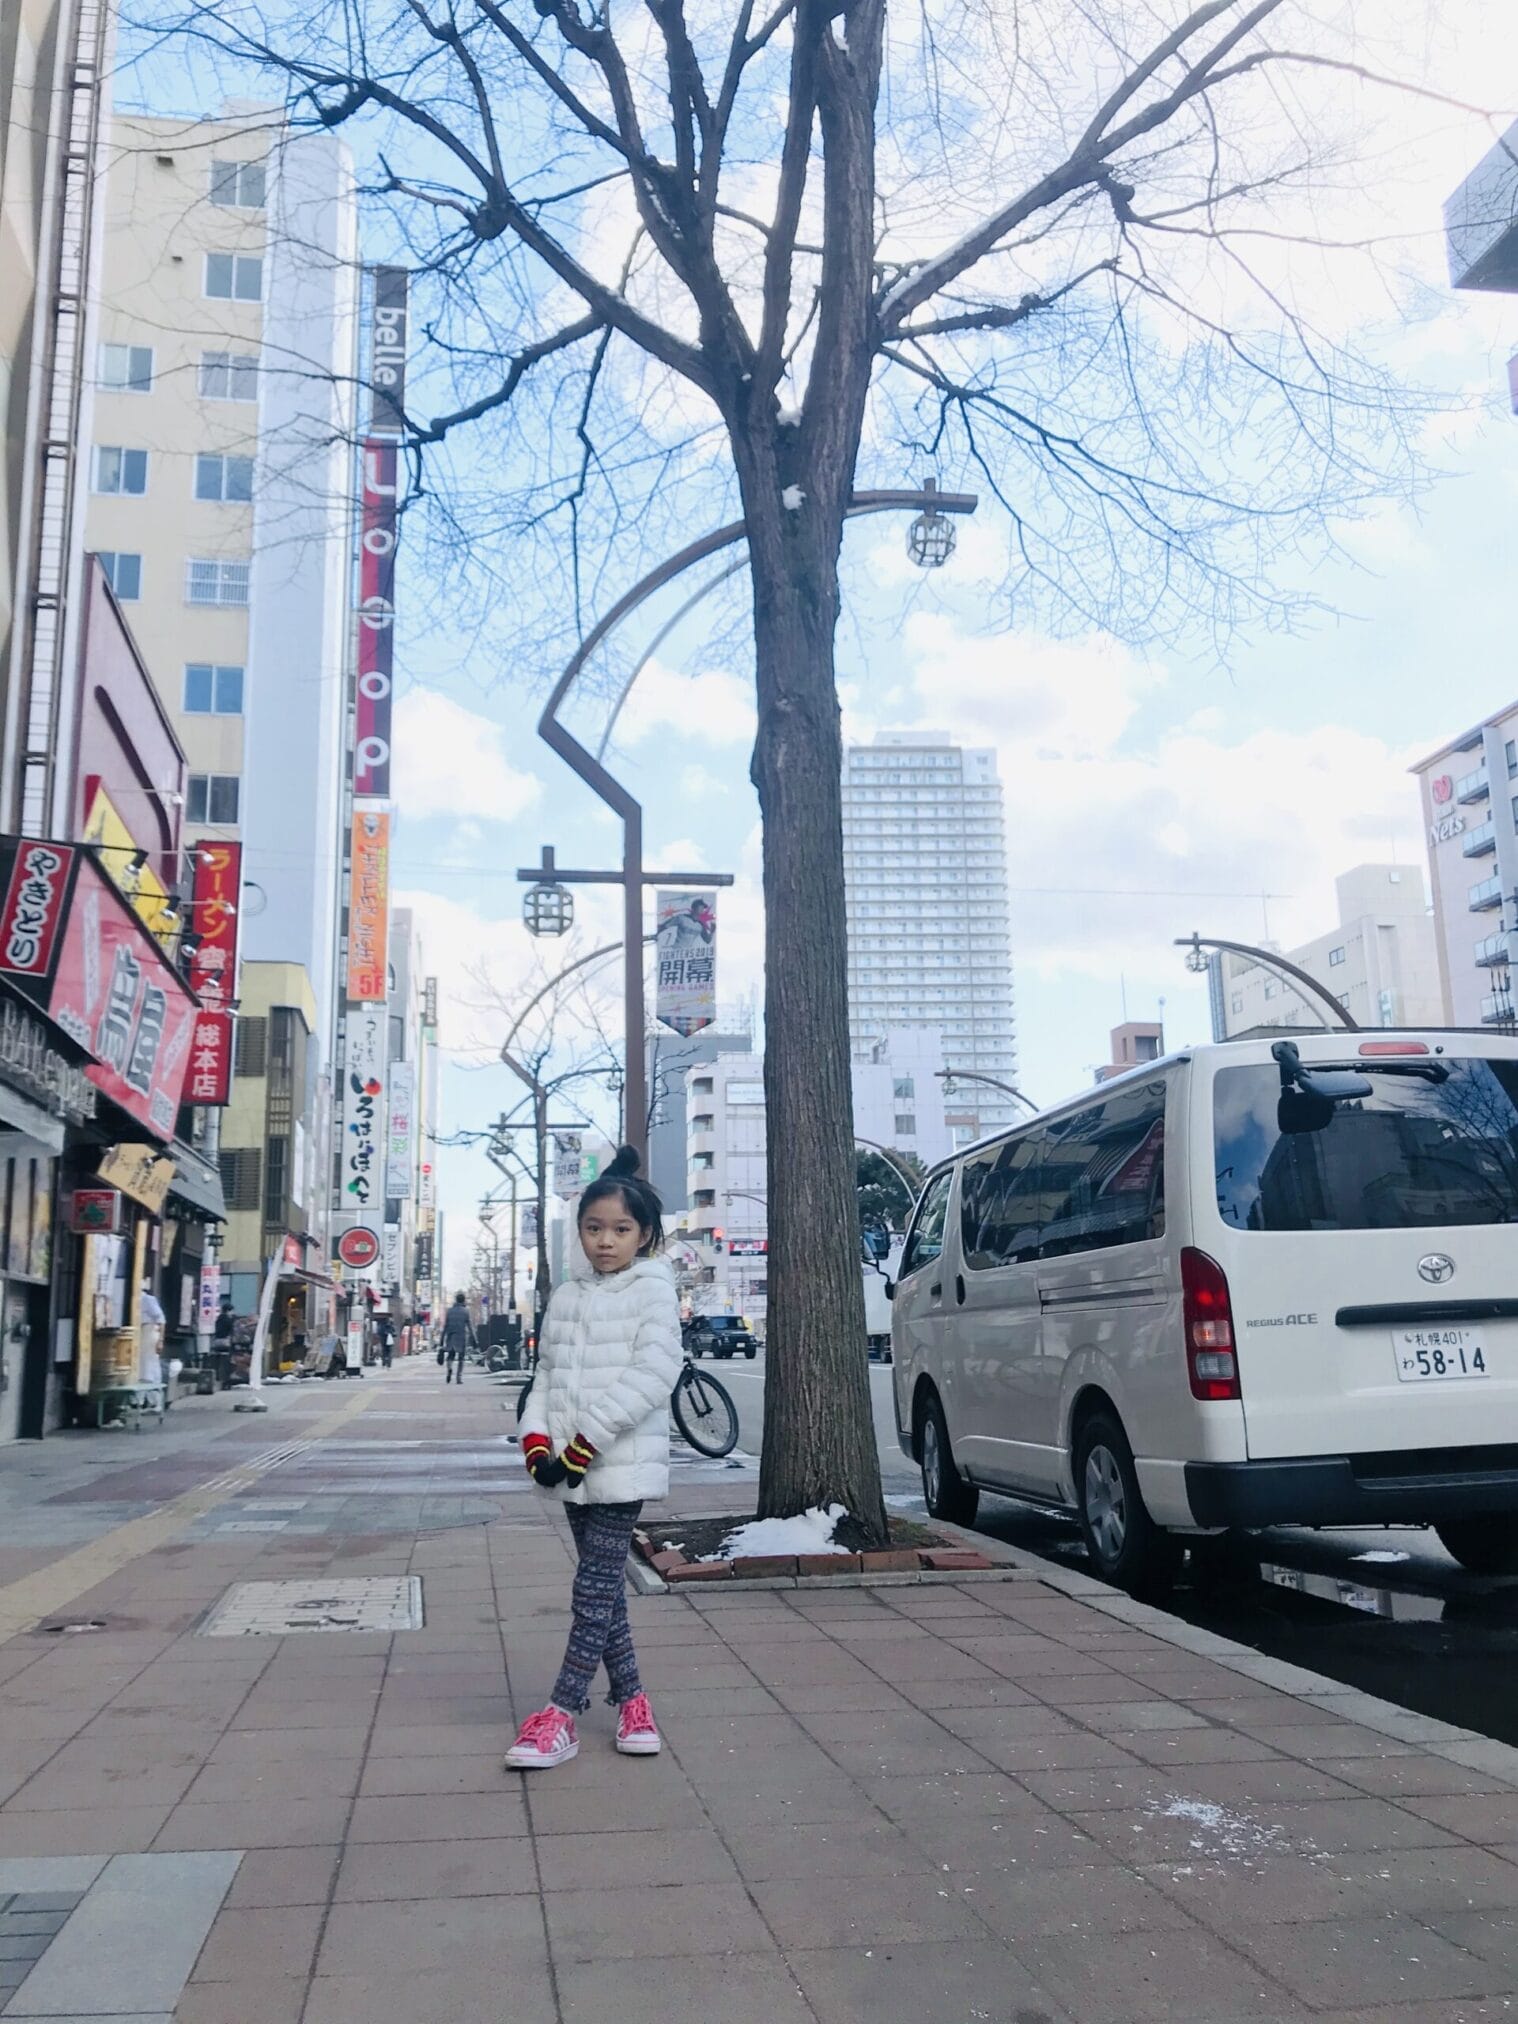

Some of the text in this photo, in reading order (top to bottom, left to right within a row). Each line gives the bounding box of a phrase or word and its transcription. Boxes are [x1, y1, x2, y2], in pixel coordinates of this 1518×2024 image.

[374, 306, 406, 385] belle
[1430, 816, 1465, 847] Nets
[9, 850, 58, 965] やきとり
[202, 848, 232, 940] ラーメン
[360, 975, 383, 995] 5F
[191, 1023, 220, 1098] 総本店
[1246, 1313, 1319, 1328] REGIUS ACE
[1402, 1347, 1486, 1376] わ 58-14
